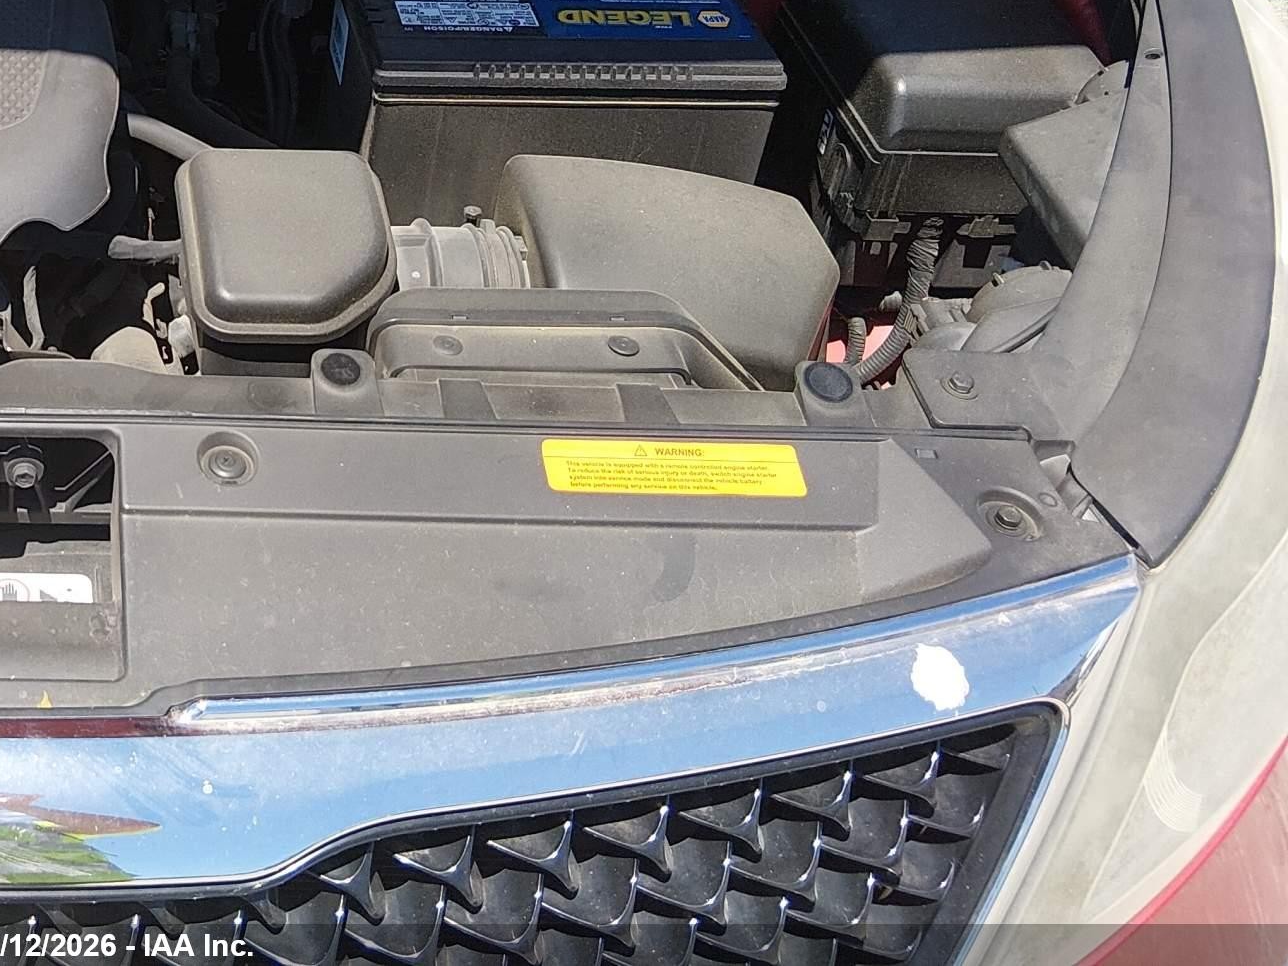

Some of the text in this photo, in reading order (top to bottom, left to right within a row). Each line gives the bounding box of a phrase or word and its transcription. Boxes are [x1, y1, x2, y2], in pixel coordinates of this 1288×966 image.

[557, 9, 693, 26] LEGEND
[702, 15, 726, 23] NAPA
[655, 447, 705, 457] WARNING:
